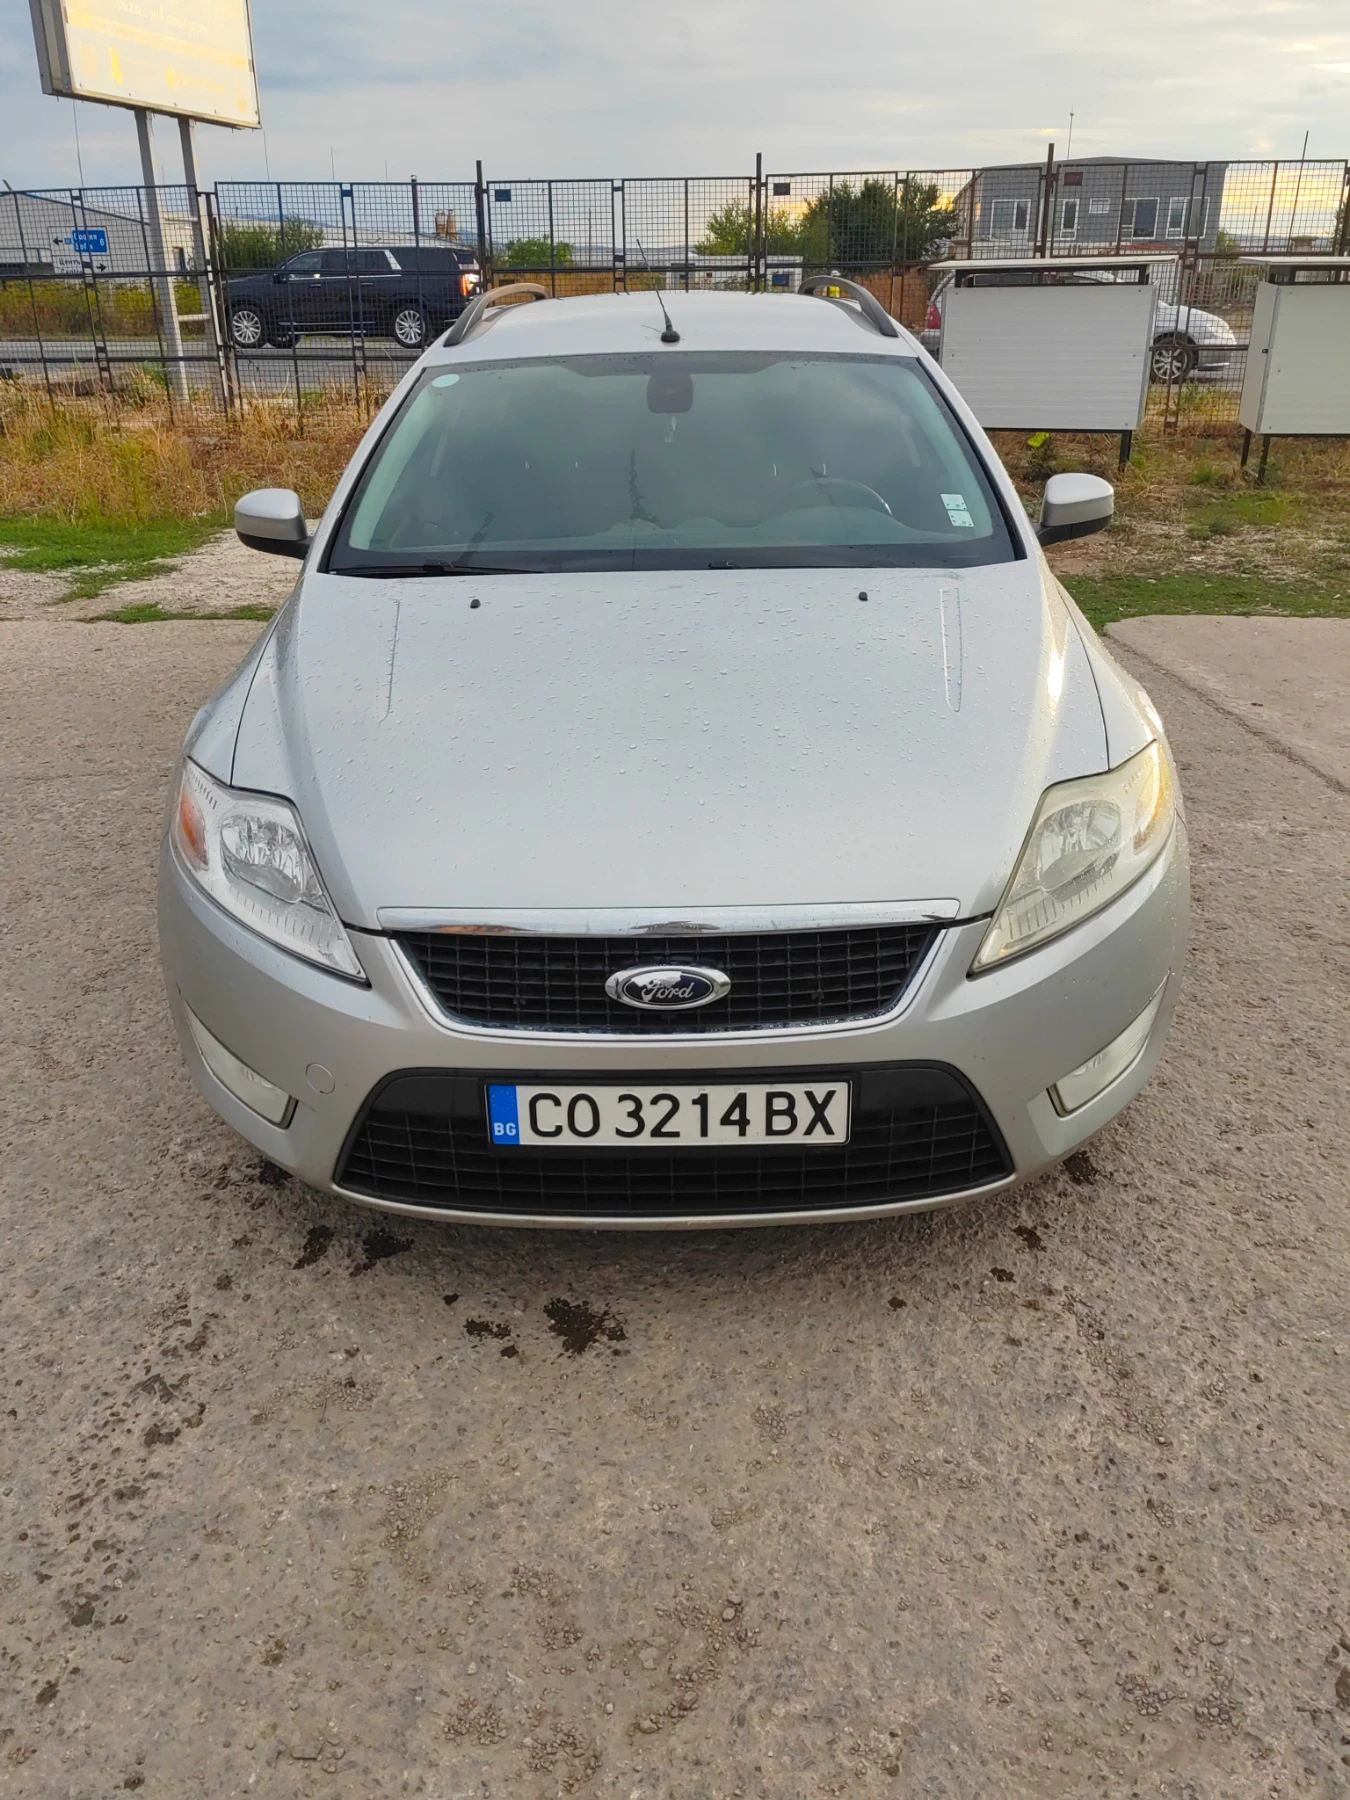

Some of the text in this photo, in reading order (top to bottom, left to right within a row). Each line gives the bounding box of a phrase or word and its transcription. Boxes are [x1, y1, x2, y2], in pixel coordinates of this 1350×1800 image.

[75, 242, 93, 251] Sofa
[59, 257, 81, 266] Центъ
[641, 979, 695, 1002] Ford
[528, 1090, 837, 1138] CO 3214 BX
[494, 1122, 517, 1136] BG
